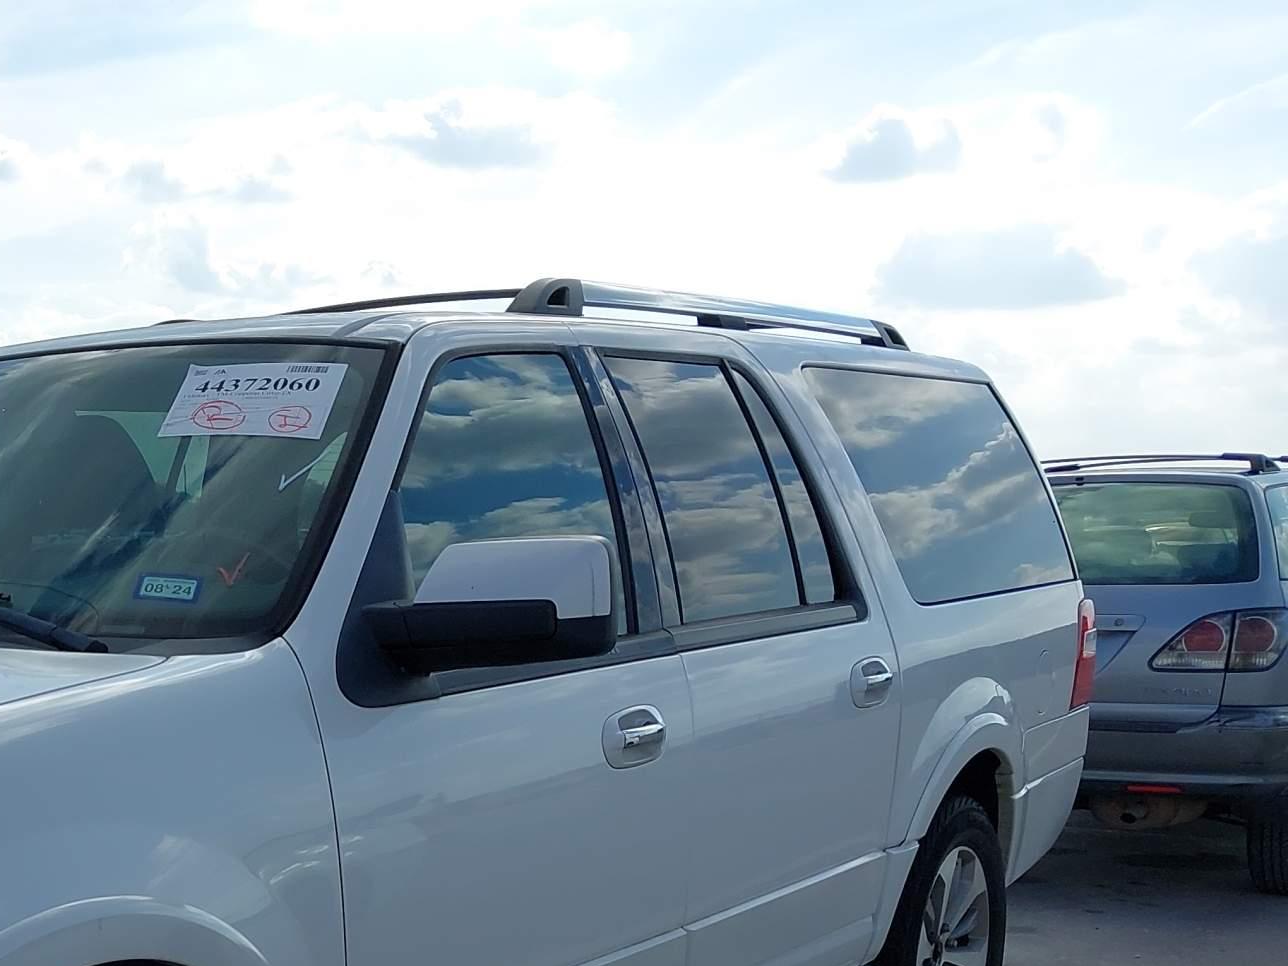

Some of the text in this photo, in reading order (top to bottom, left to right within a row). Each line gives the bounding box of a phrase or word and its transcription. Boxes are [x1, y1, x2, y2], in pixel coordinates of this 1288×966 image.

[194, 376, 321, 394] 44372060
[144, 582, 192, 596] 08 24
